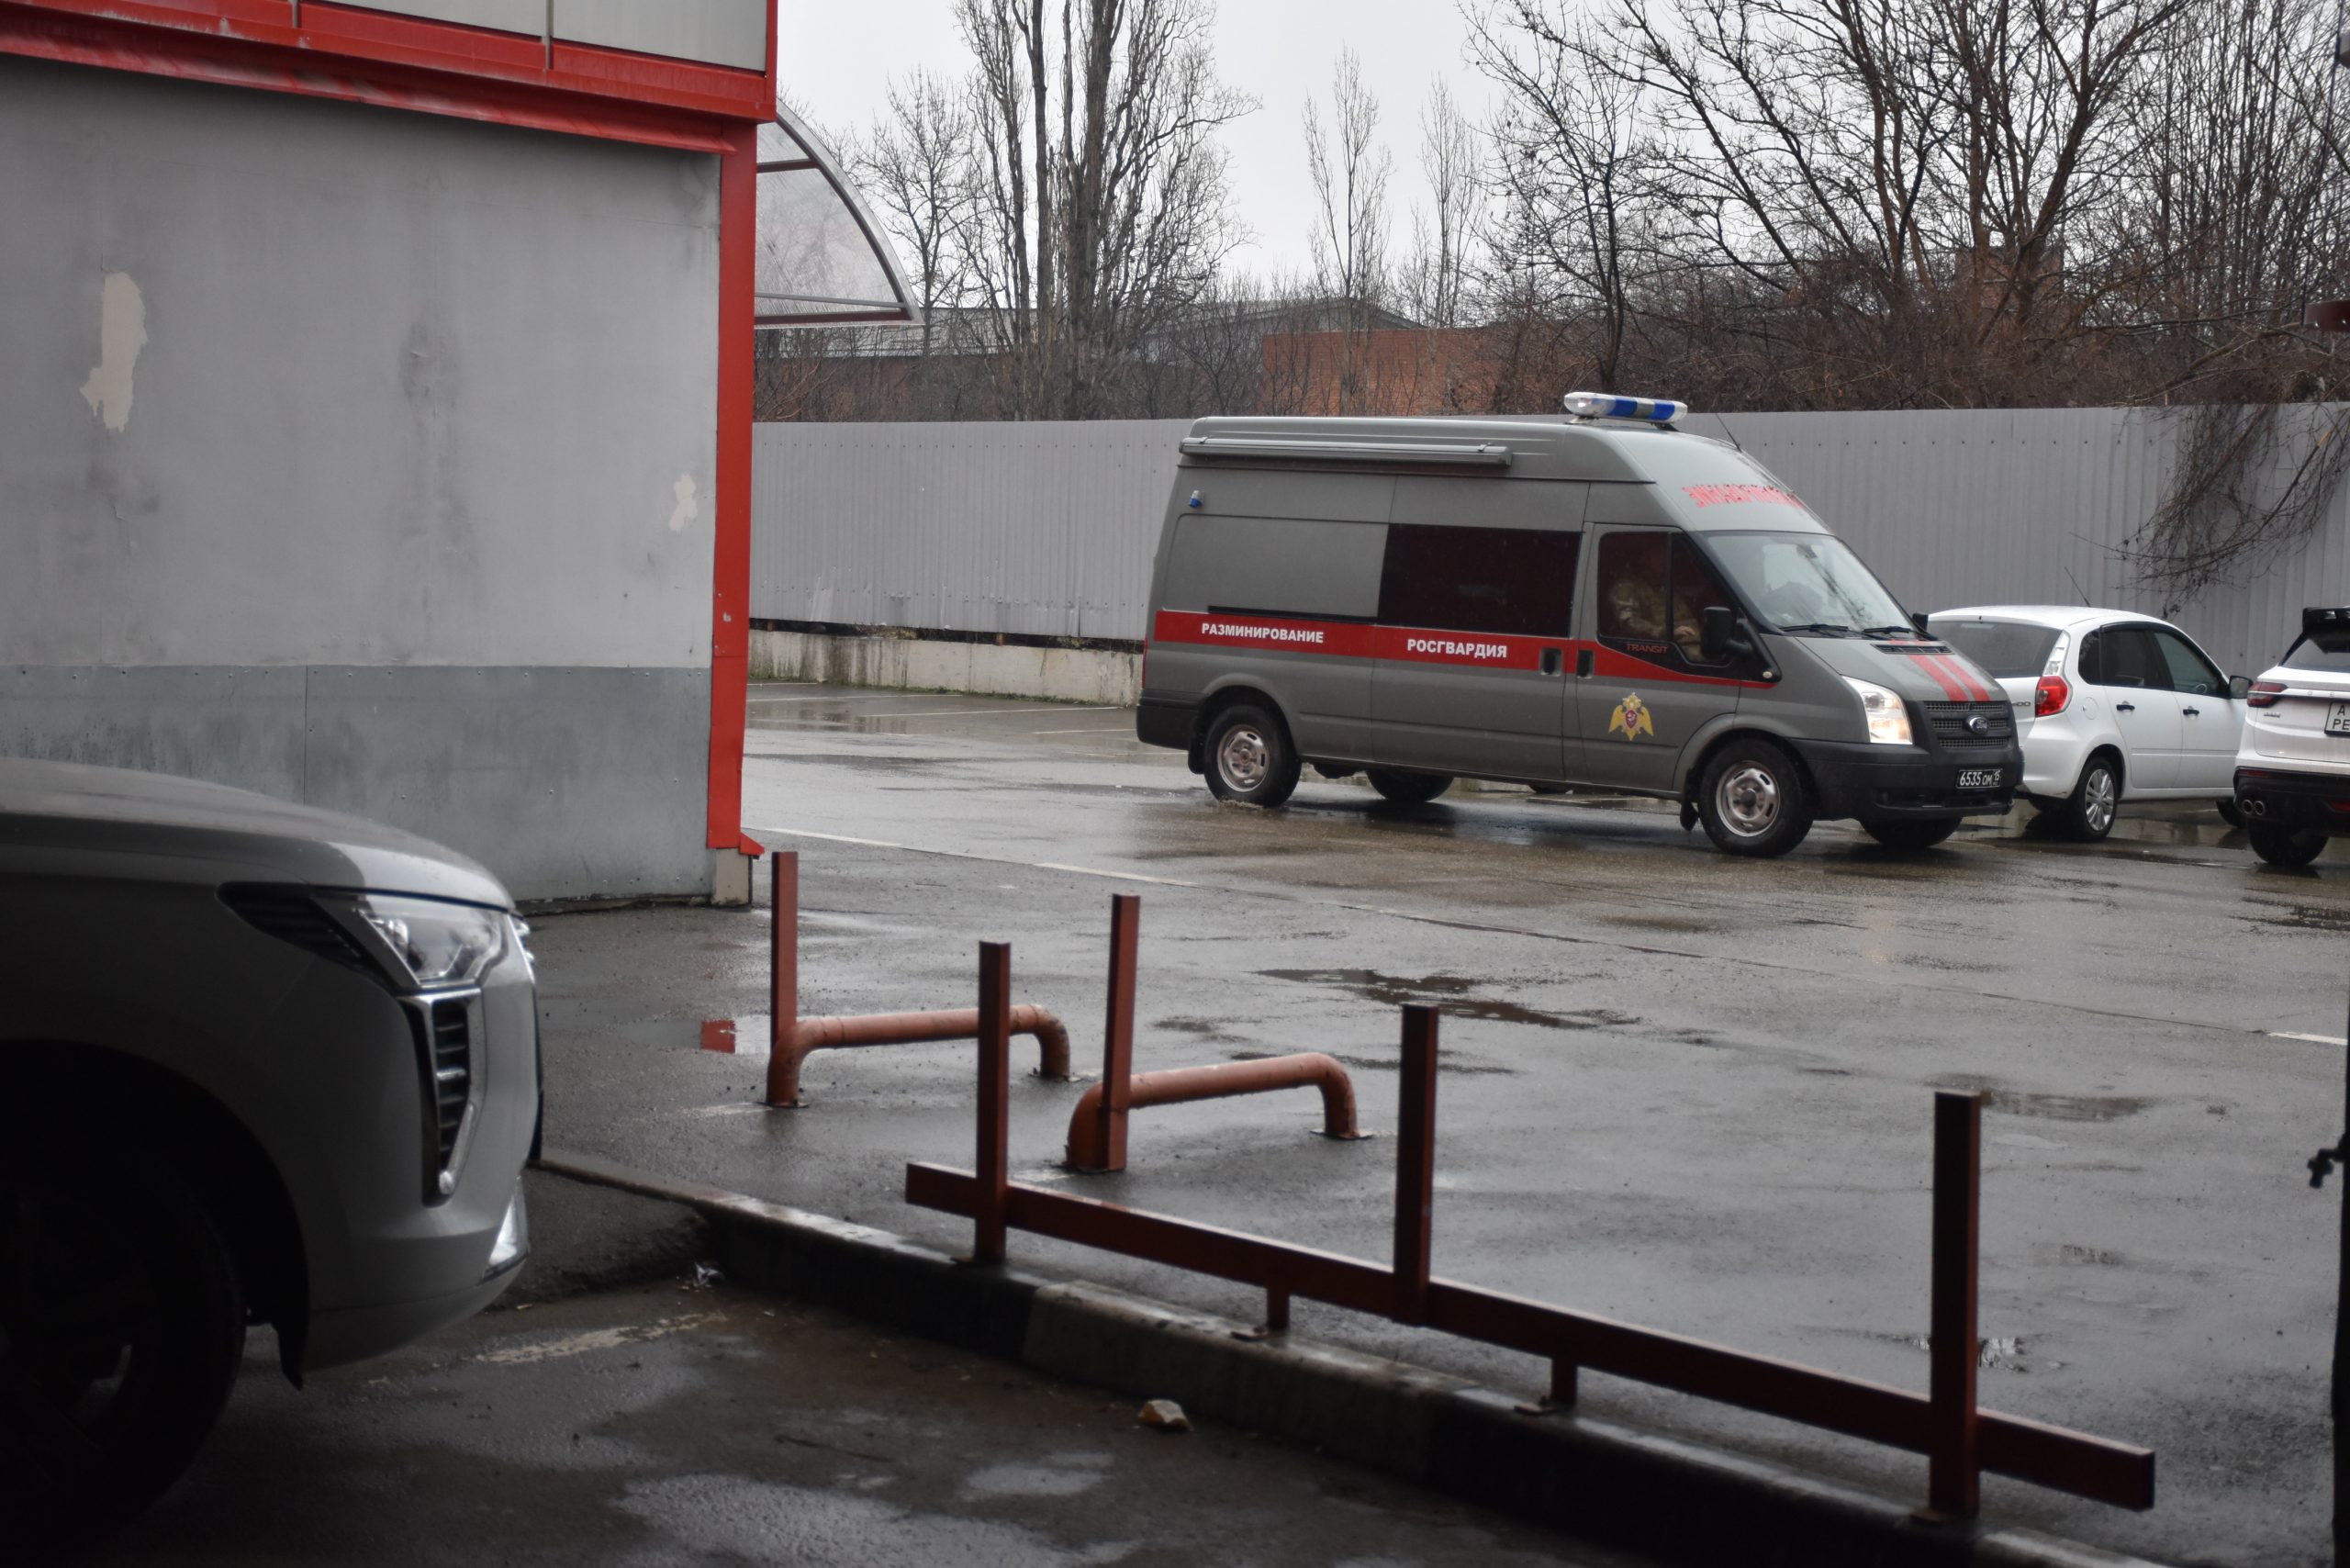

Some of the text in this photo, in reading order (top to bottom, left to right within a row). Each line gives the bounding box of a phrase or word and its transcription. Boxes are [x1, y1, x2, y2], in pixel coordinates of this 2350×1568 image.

[1202, 622, 1325, 644] РАЗМИНИРОВАНИЕ
[1407, 638, 1507, 659] РОСГВАРДИЯ
[1627, 643, 1668, 654] TRANSIT
